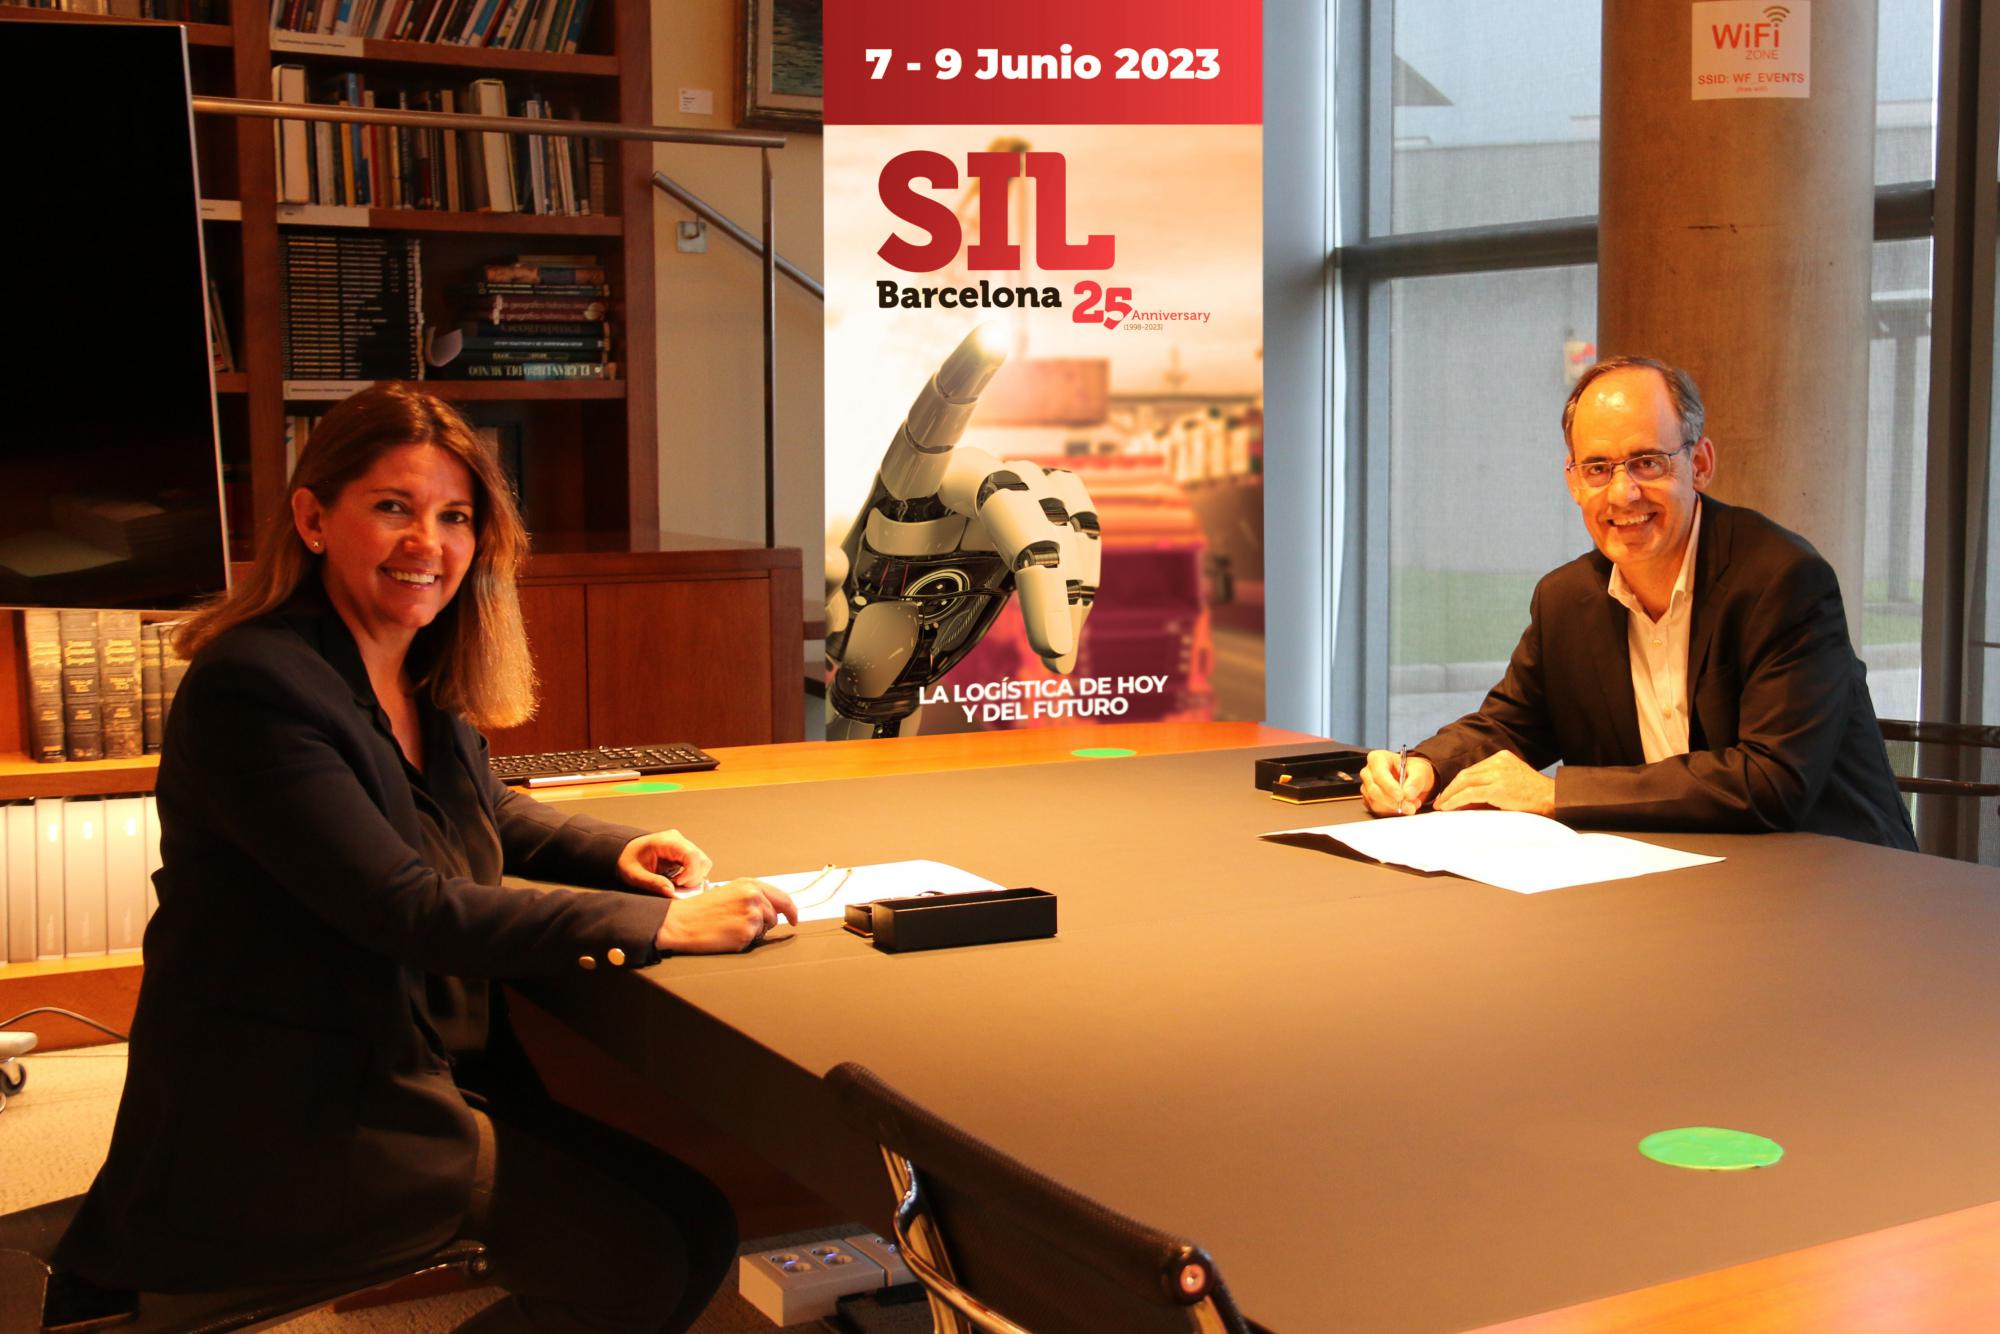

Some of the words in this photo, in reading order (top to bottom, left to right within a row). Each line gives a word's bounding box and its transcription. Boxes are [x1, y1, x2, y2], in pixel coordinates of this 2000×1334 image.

[1711, 22, 1780, 49] WiFi
[865, 48, 893, 80] 7
[906, 62, 921, 71] -
[934, 48, 962, 80] 9
[974, 44, 1102, 80] Junio
[1114, 48, 1221, 80] 2023
[1745, 50, 1779, 60] ZONE
[1698, 74, 1728, 85] SSID:
[876, 150, 1116, 273] SIL
[876, 280, 1062, 309] Barcelona
[1072, 280, 1133, 330] 25
[1131, 310, 1211, 323] Anniversary
[918, 685, 949, 704] LA
[953, 676, 1075, 702] LOGÍSTICA
[1079, 677, 1112, 696] DE
[1117, 674, 1169, 694] HOY
[961, 704, 979, 723] Y
[982, 702, 1029, 722] DEL
[1033, 697, 1129, 718] FUTURO
